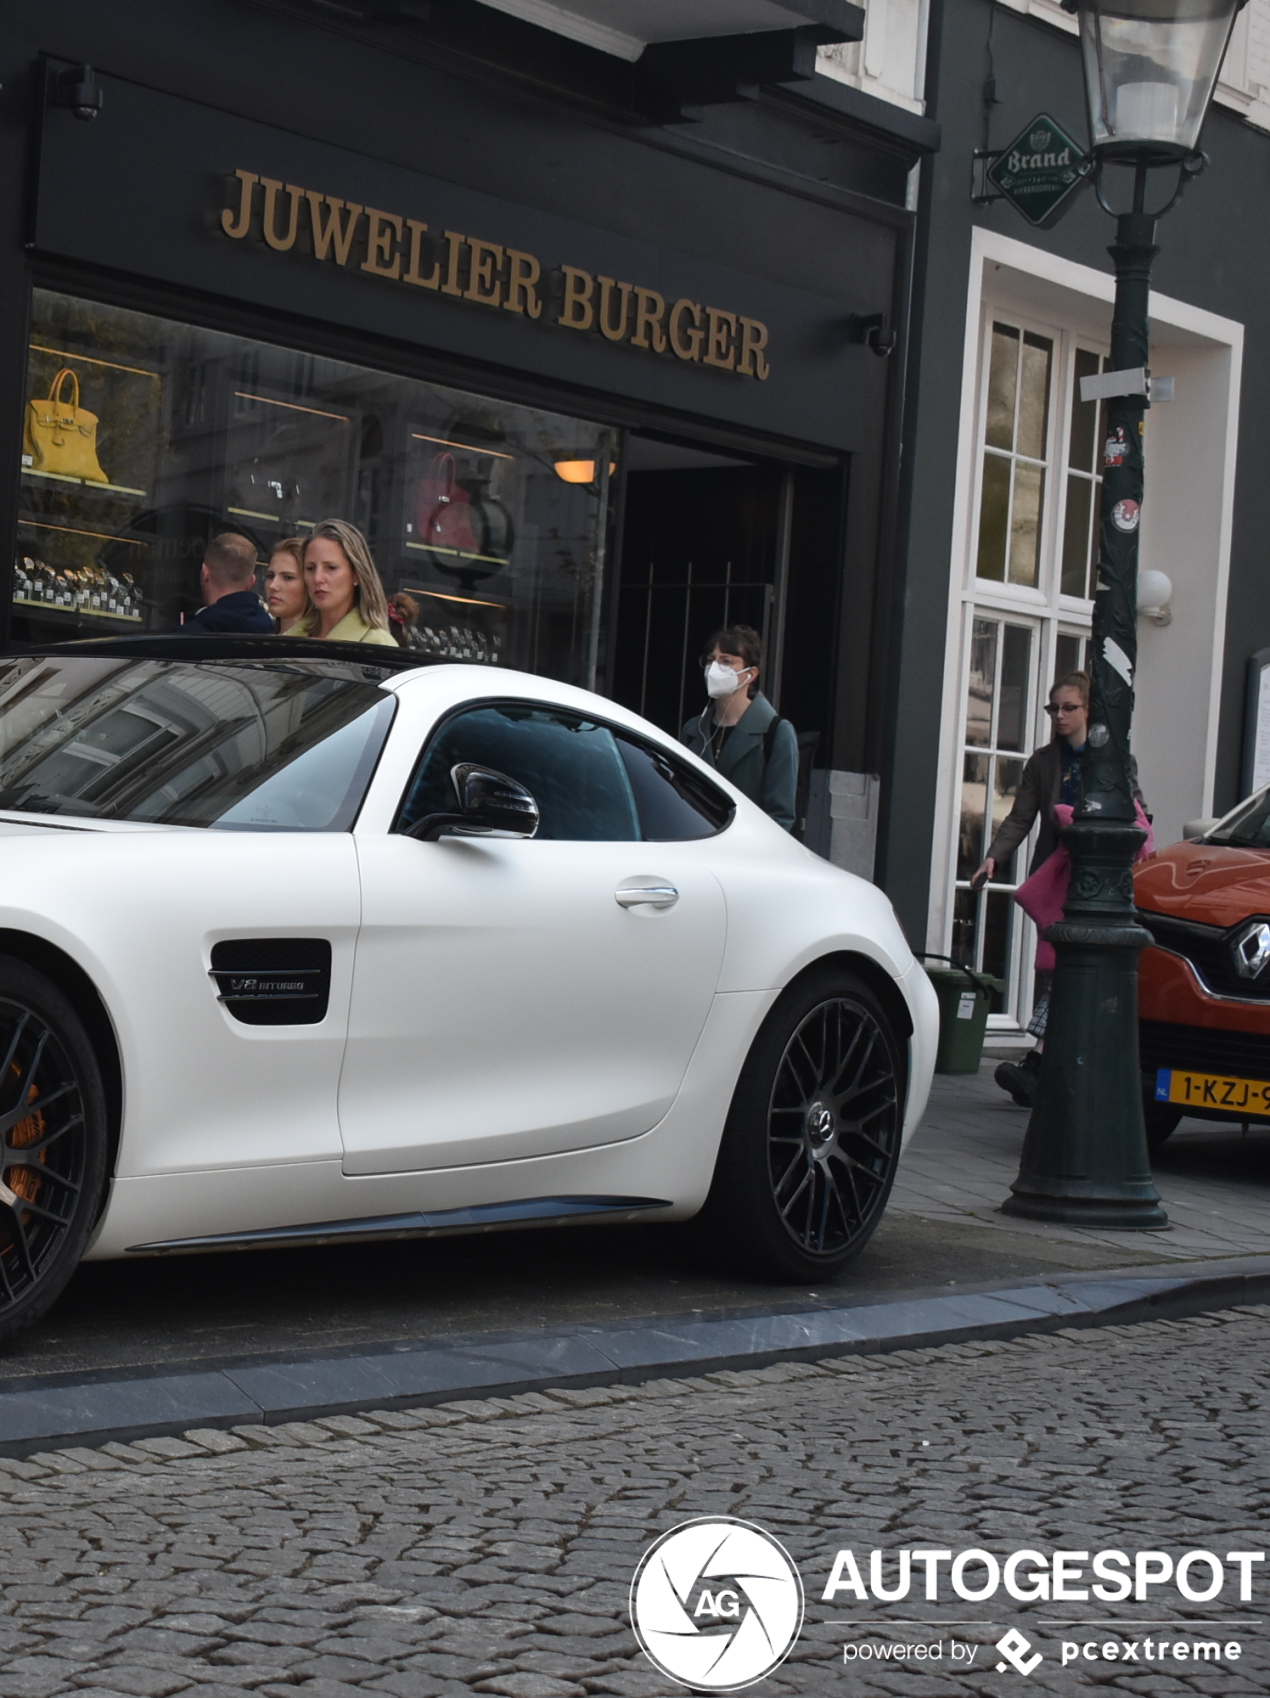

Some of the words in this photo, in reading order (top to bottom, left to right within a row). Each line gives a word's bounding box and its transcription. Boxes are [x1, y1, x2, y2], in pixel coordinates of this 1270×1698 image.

[1007, 147, 1071, 174] Brand
[221, 168, 542, 320] JUWELIER
[558, 264, 771, 381] BURGER
[230, 979, 258, 990] V8
[258, 982, 305, 990] BITURBO
[1157, 1087, 1168, 1096] NL
